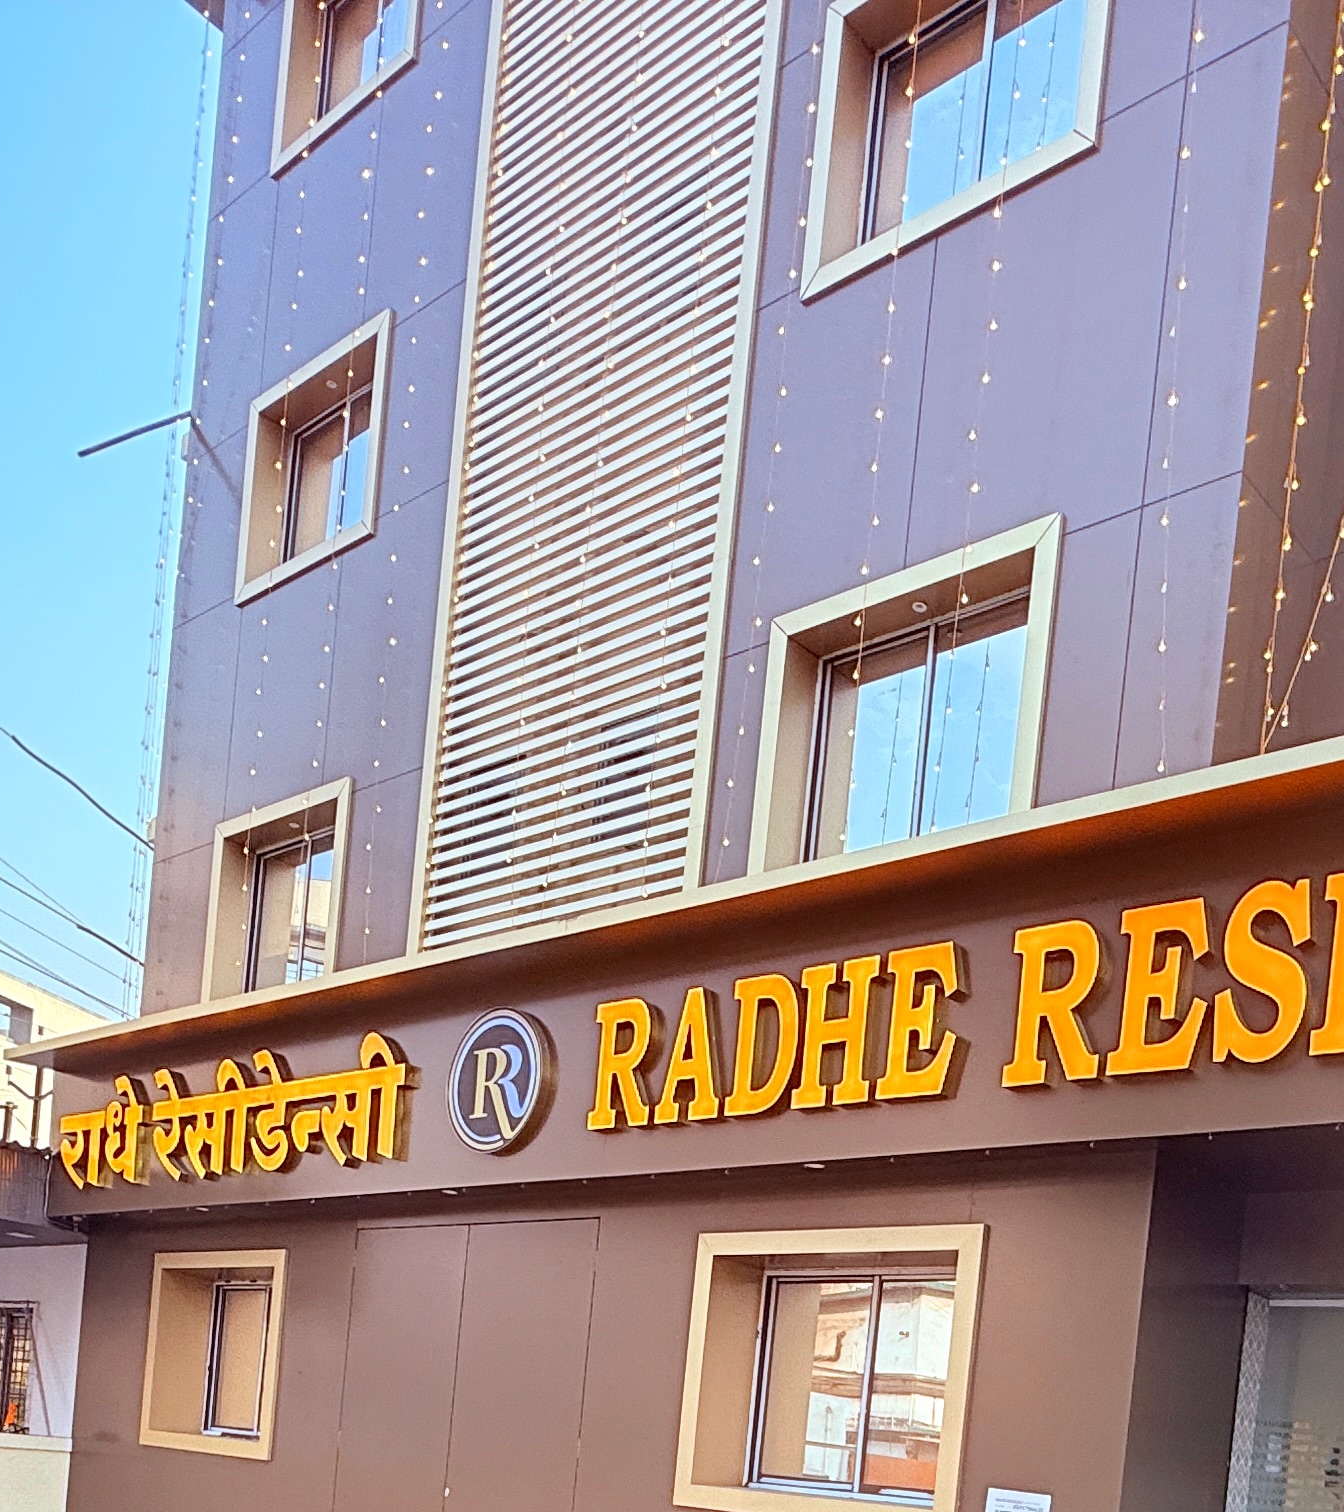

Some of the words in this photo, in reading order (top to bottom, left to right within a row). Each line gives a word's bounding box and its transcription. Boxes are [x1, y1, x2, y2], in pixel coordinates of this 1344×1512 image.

[60, 1075, 143, 1190] राधे
[153, 1032, 405, 1181] रेसीडेन्सी
[586, 941, 957, 1130] RADHE
